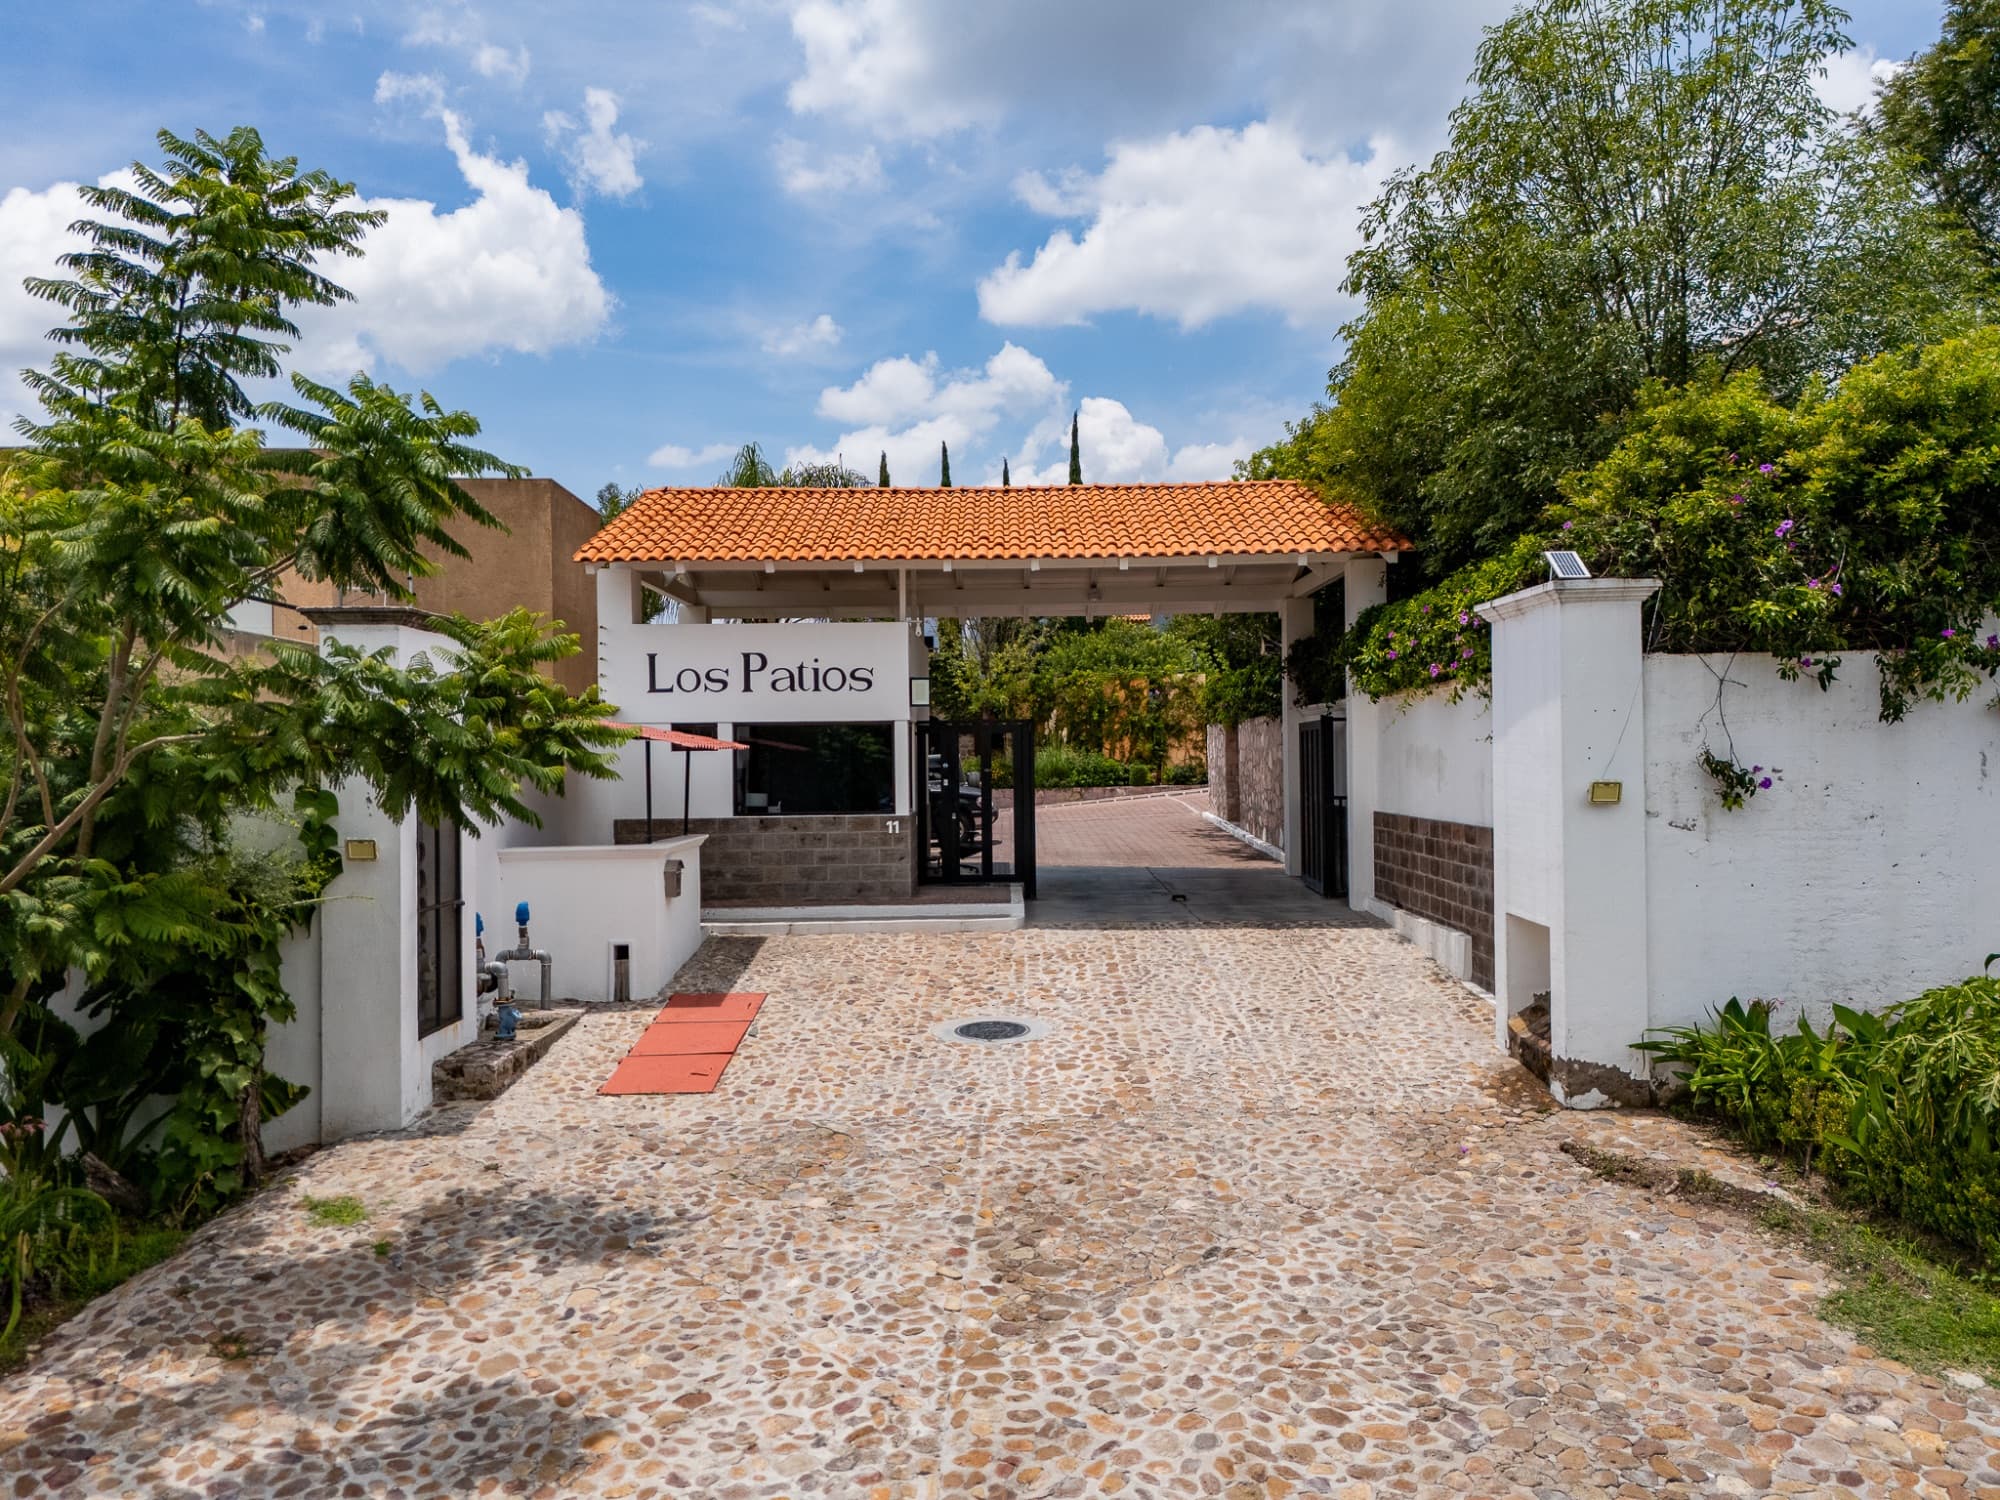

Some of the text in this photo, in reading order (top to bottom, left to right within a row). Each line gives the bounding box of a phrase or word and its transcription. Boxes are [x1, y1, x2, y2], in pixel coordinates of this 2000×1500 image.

[646, 651, 874, 693] Los Patios
[886, 820, 899, 833] 11
